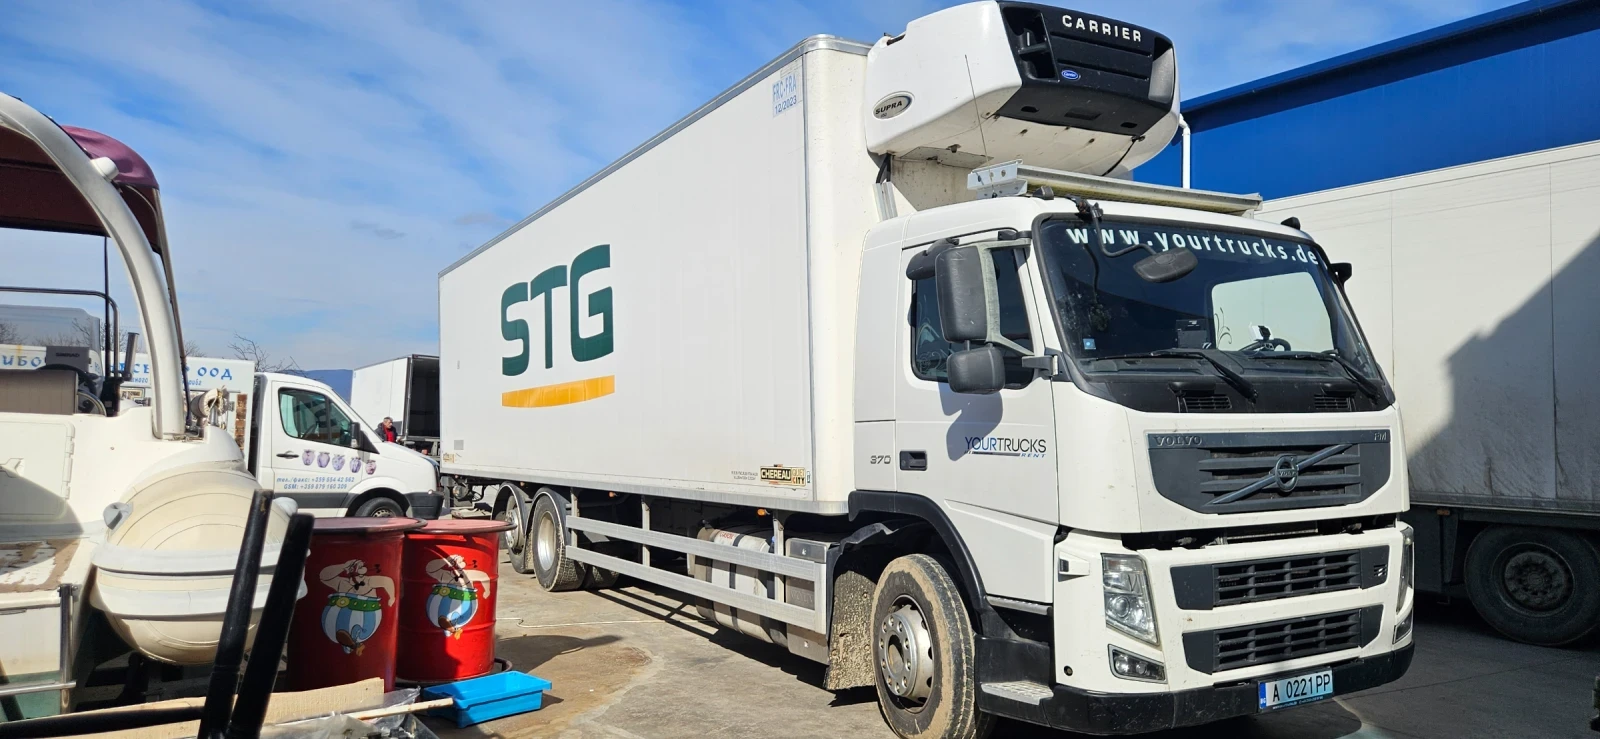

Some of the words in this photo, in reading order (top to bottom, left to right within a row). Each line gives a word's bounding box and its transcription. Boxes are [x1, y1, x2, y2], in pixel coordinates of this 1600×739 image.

[1062, 14, 1141, 42] CARRIER
[773, 74, 797, 102] FRC-FRA
[775, 95, 797, 114] 12/2023
[876, 100, 903, 115] SUPRA
[1066, 228, 1319, 265] www.yourtrucks.de
[501, 244, 614, 376] STG
[197, 366, 232, 380] ООД
[1153, 435, 1202, 447] VOLVO
[1374, 432, 1387, 441] FM
[965, 437, 1046, 453] YOURTRUCKS
[870, 455, 892, 465] 370
[761, 469, 790, 480] CHEREAU
[1273, 684, 1280, 702] A
